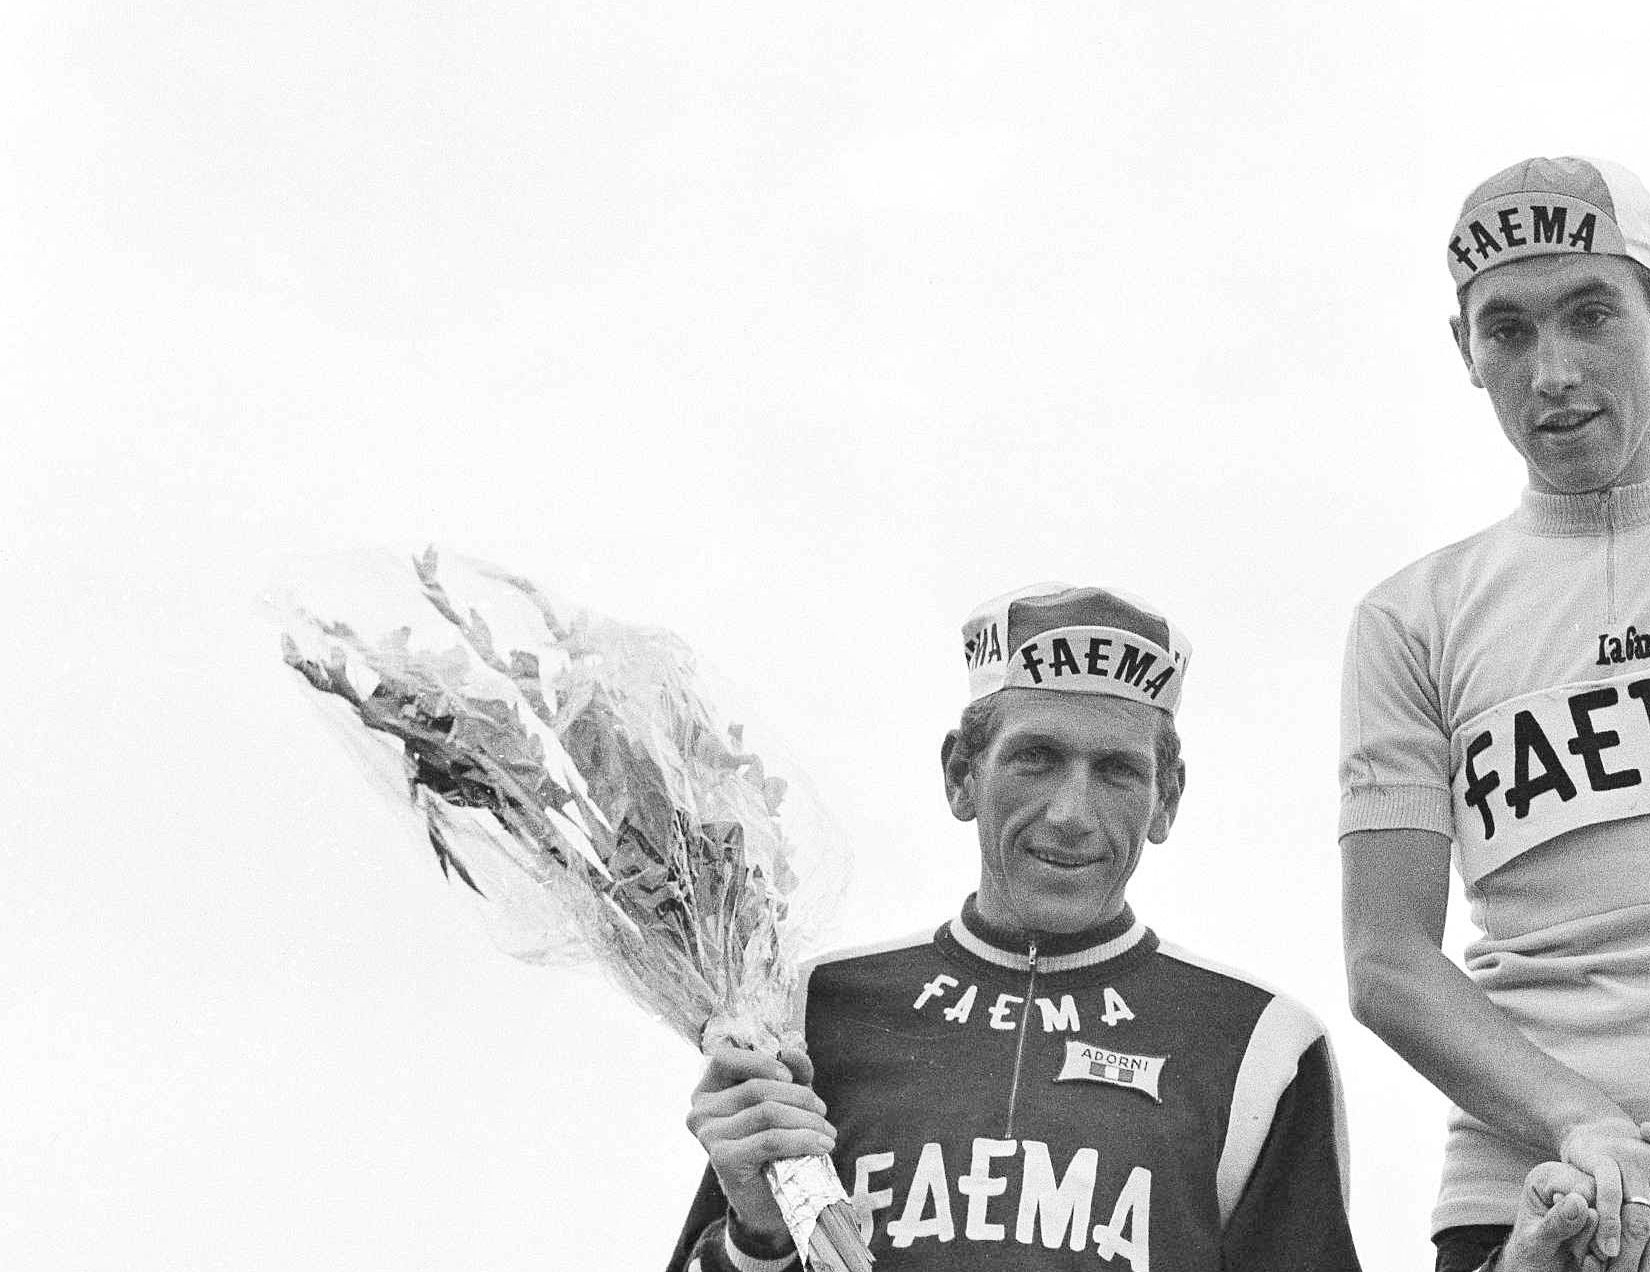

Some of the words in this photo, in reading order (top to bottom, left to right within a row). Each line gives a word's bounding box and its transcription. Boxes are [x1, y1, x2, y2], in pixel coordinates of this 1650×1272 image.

[1449, 205, 1597, 272] FAEMA
[1021, 637, 1175, 699] FAEMA
[913, 974, 1135, 1032] FAEMA
[1081, 1048, 1148, 1072] ADORNI
